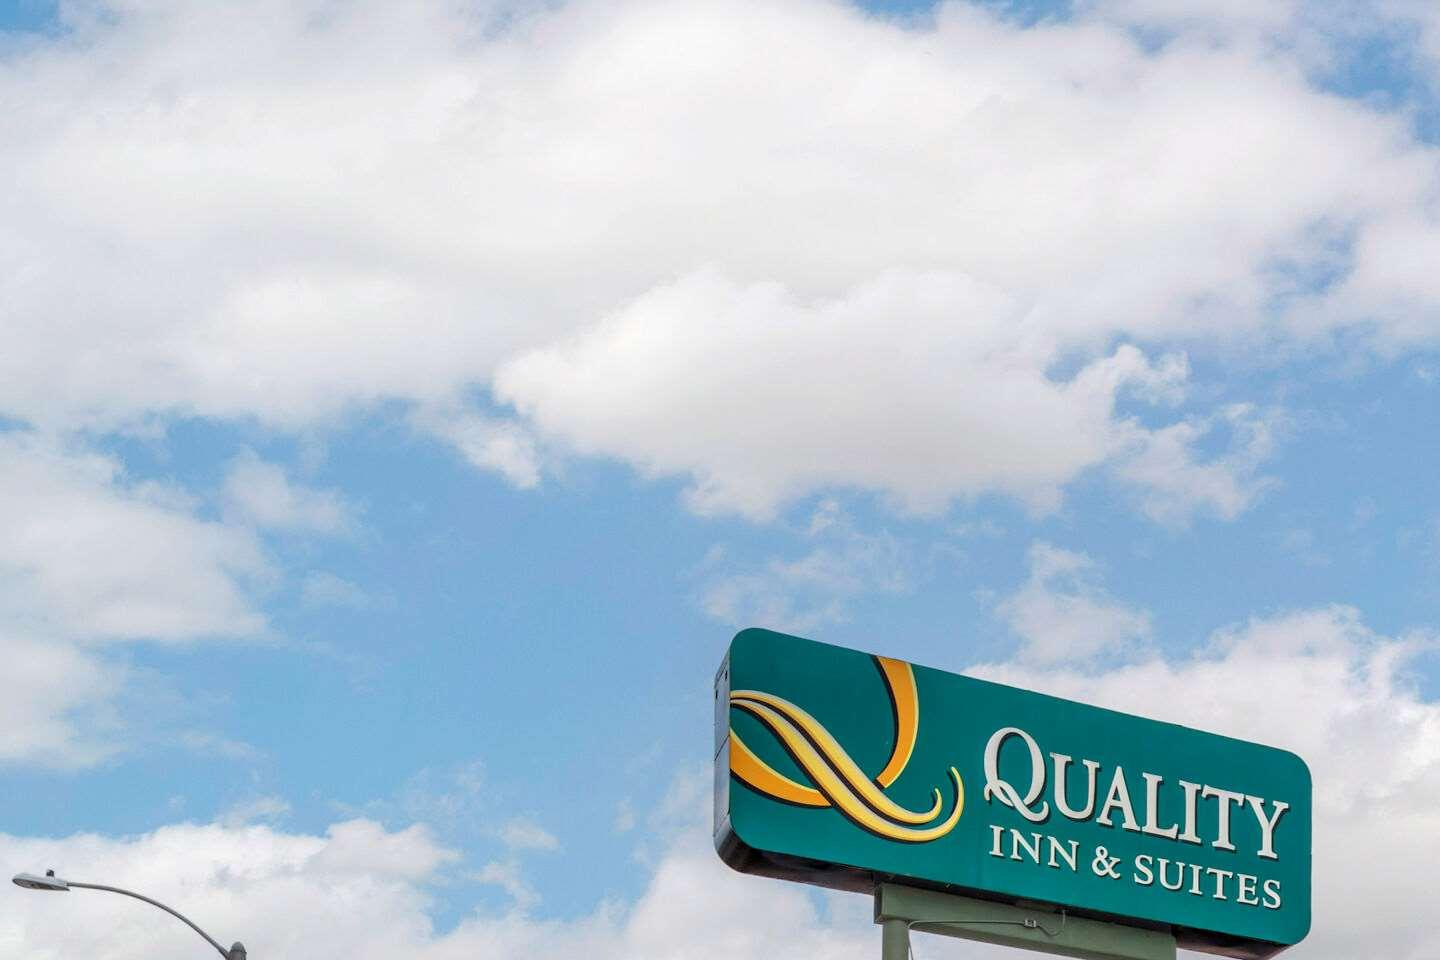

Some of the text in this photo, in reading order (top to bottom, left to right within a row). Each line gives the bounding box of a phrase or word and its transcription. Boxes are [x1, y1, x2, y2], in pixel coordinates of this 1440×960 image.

[984, 727, 1289, 859] QUALITY
[989, 824, 1281, 909] INN & SUITES
